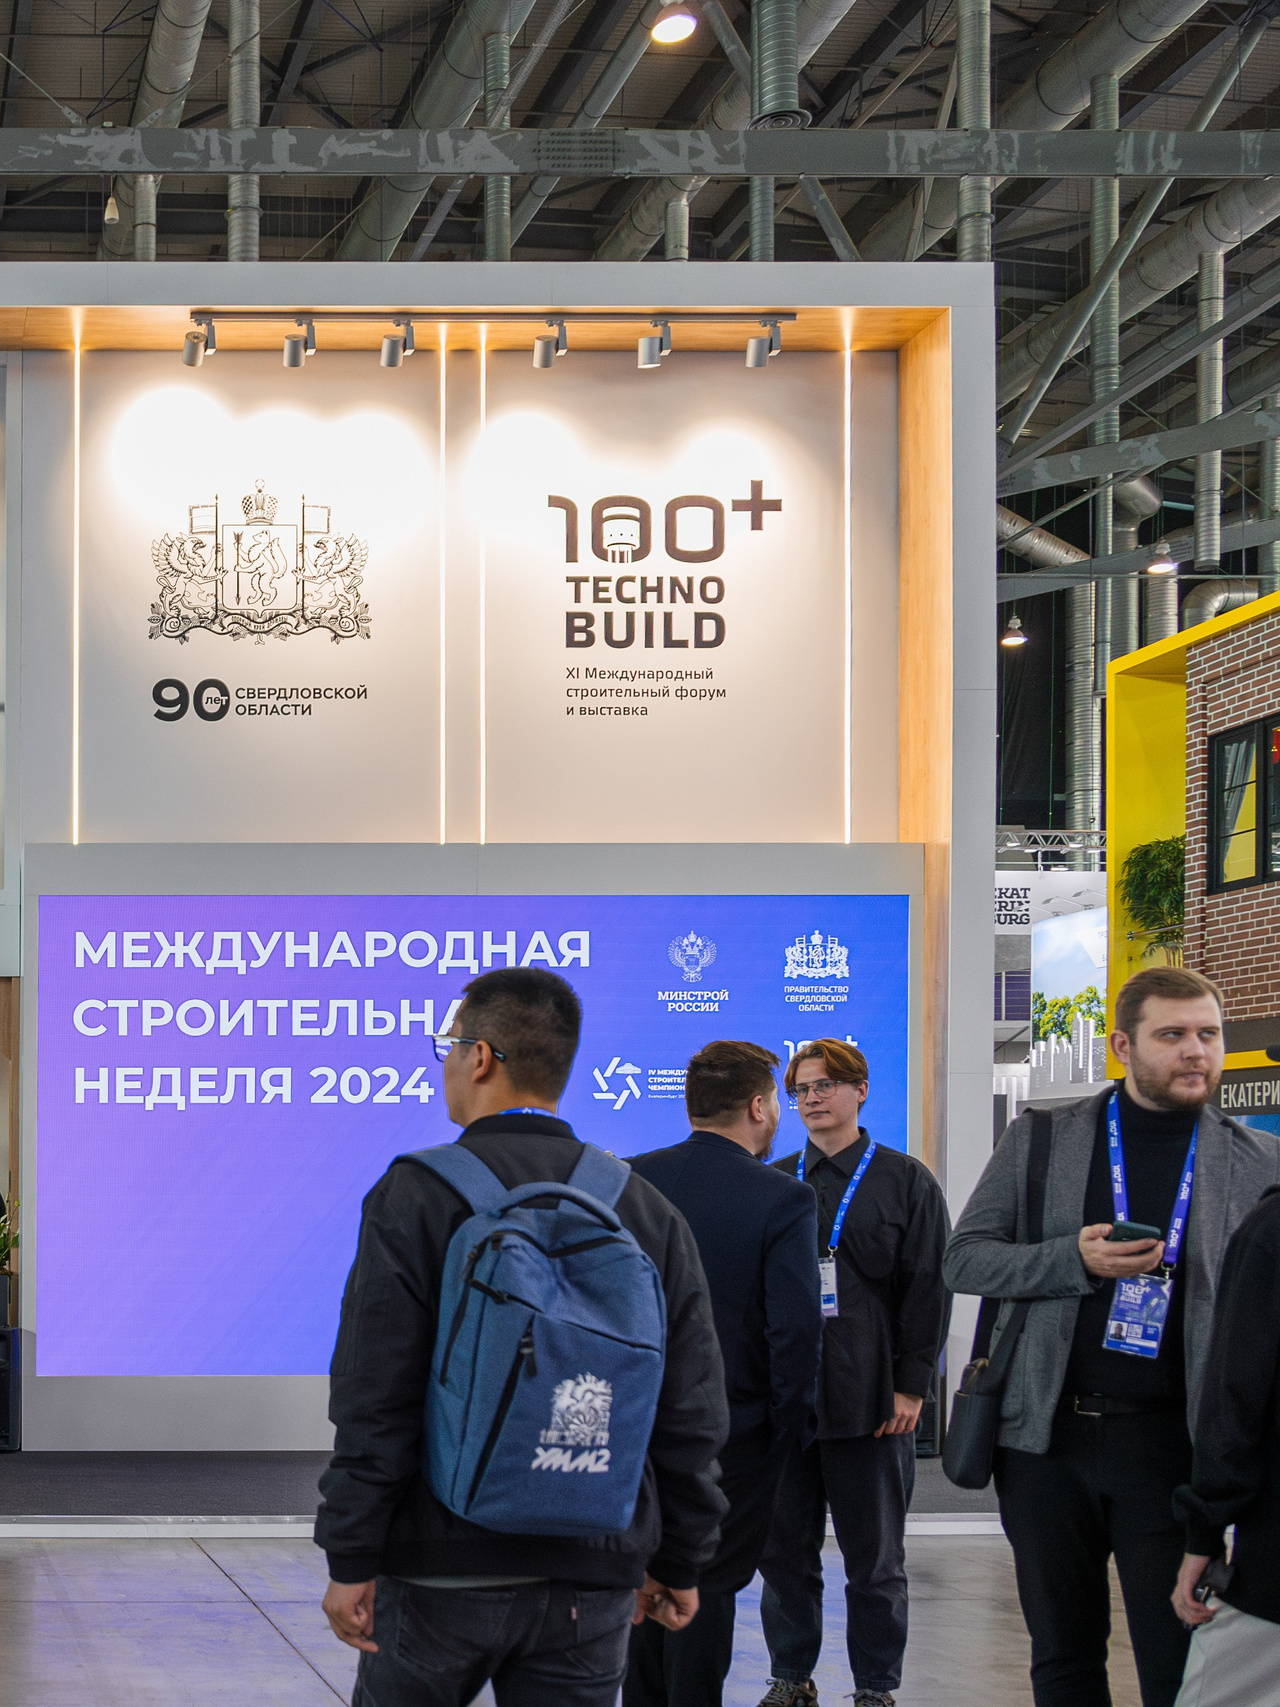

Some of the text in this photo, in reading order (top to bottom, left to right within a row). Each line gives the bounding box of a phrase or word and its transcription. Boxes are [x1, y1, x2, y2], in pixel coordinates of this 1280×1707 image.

[565, 575, 725, 604] TECHNO
[565, 611, 726, 649] BUILD
[566, 667, 713, 682] XI Международный
[152, 678, 230, 722] 90 лет
[235, 685, 368, 701] СВЕРДЛОВСКОЙ
[566, 686, 726, 701] строительный форум
[235, 704, 312, 716] ОБЛАСТИ
[566, 706, 648, 716] и выставка
[995, 901, 1031, 912] RIN
[995, 913, 1030, 925] URG
[75, 930, 591, 975] МЕЖДУНАРОДНАЯ
[657, 989, 729, 1001] МИНСТРОЙ
[785, 994, 848, 1003] СВЕРДЛОВСКОЙ
[667, 1002, 719, 1012] РОССИИ
[798, 1004, 834, 1012] ОБЛАСТИ
[75, 1066, 435, 1111] НЕДЕЛЯ 2024
[1221, 1080, 1280, 1108] ЕКАТЕРИ
